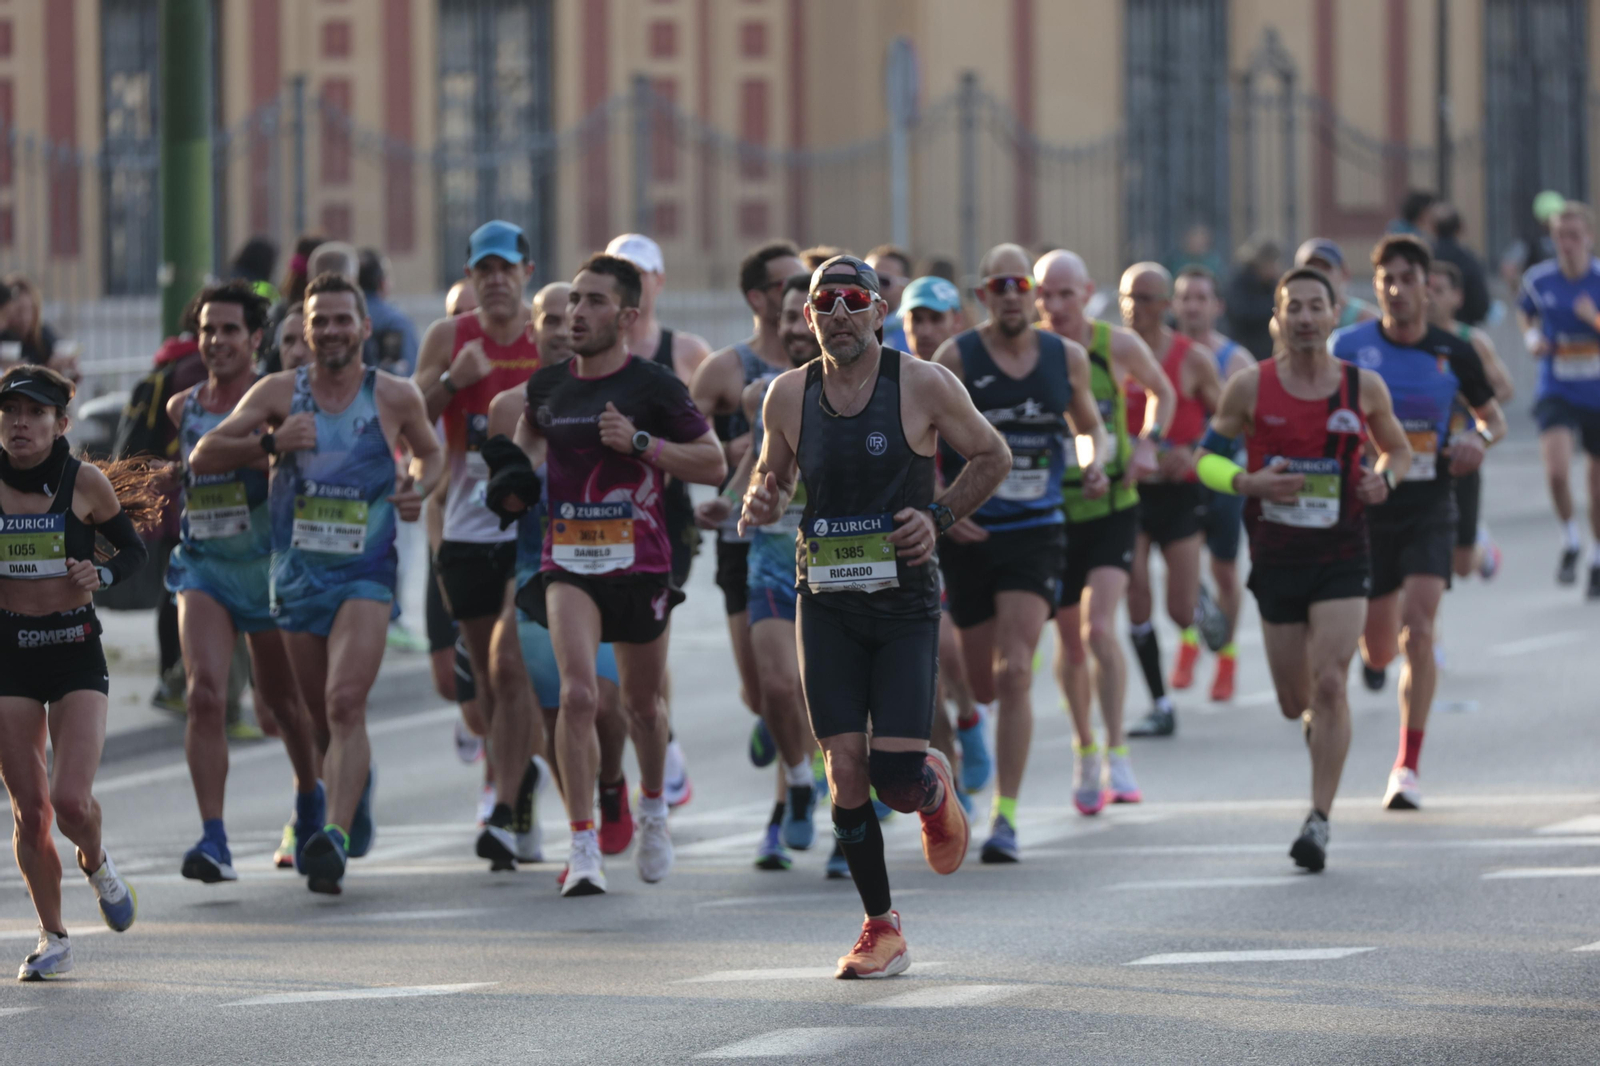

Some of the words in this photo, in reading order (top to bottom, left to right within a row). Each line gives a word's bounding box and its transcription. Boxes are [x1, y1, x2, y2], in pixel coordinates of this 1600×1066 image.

[318, 484, 360, 497] ZURICH
[576, 505, 623, 518] ZURICH
[6, 517, 55, 531] ZURICH
[831, 518, 882, 533] ZURICH
[7, 543, 36, 556] 1055
[834, 545, 865, 560] 1385
[9, 563, 38, 574] DIANA
[829, 565, 873, 579] RICARDO
